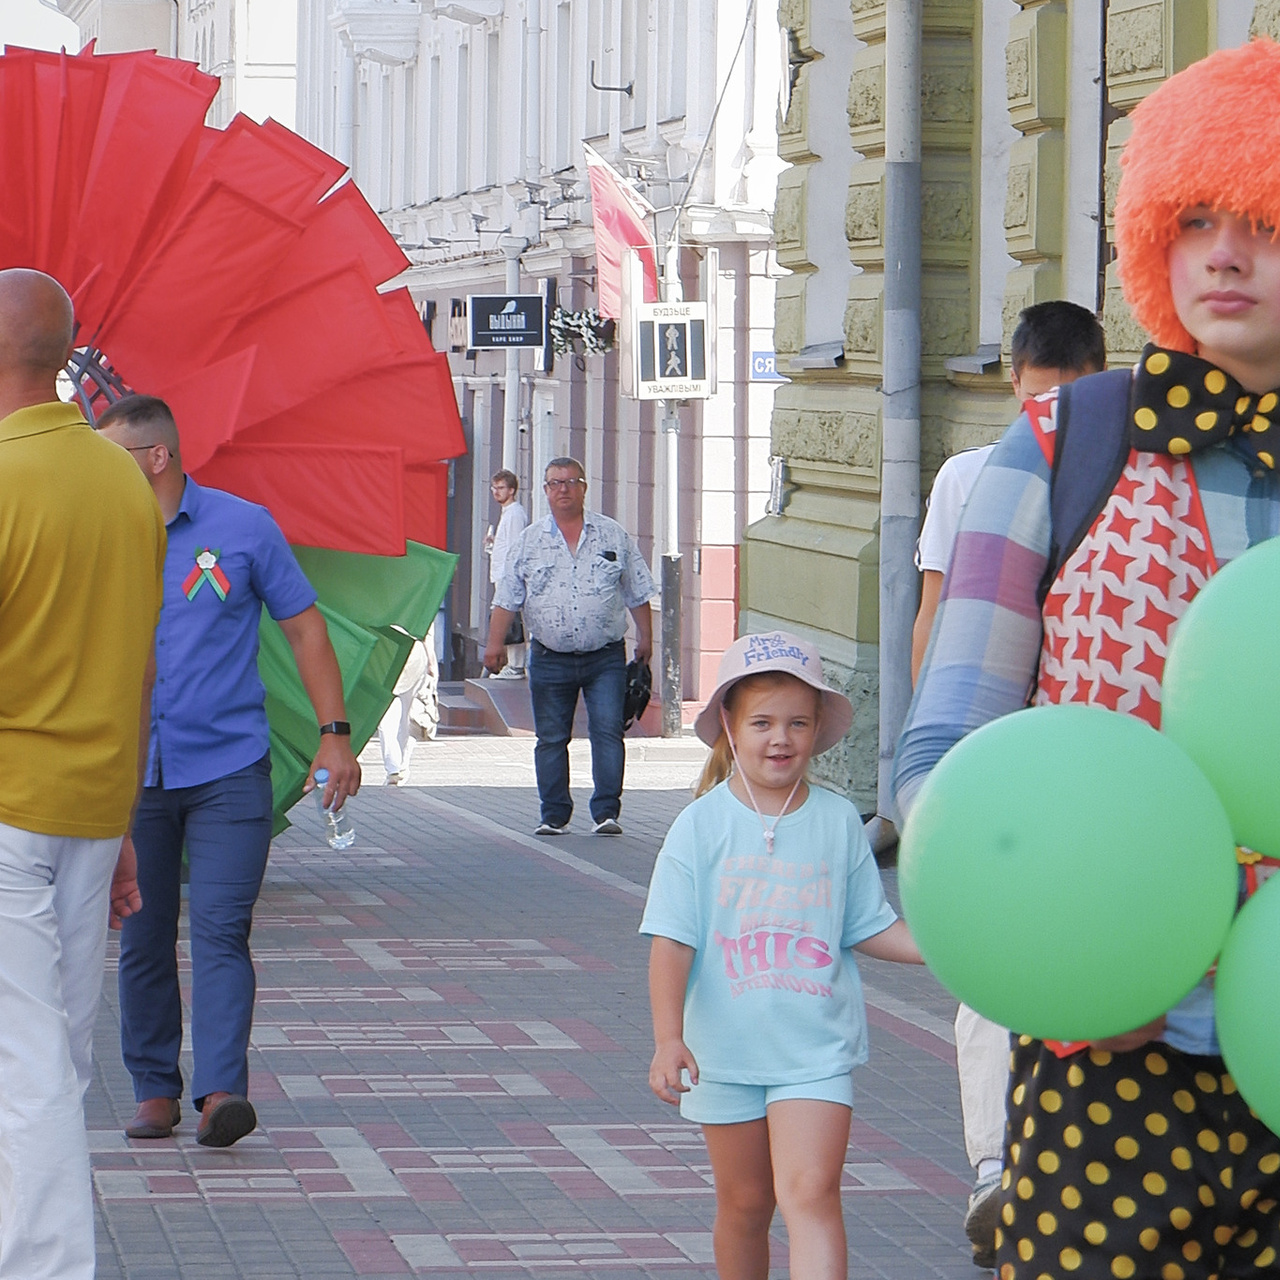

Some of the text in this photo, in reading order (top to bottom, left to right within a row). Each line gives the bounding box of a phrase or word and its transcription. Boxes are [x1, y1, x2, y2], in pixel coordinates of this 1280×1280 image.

[743, 646, 809, 667] Friendly
[717, 875, 832, 911] FRESH
[714, 930, 833, 980] THIS
[730, 973, 833, 1000] AFTERNOON
